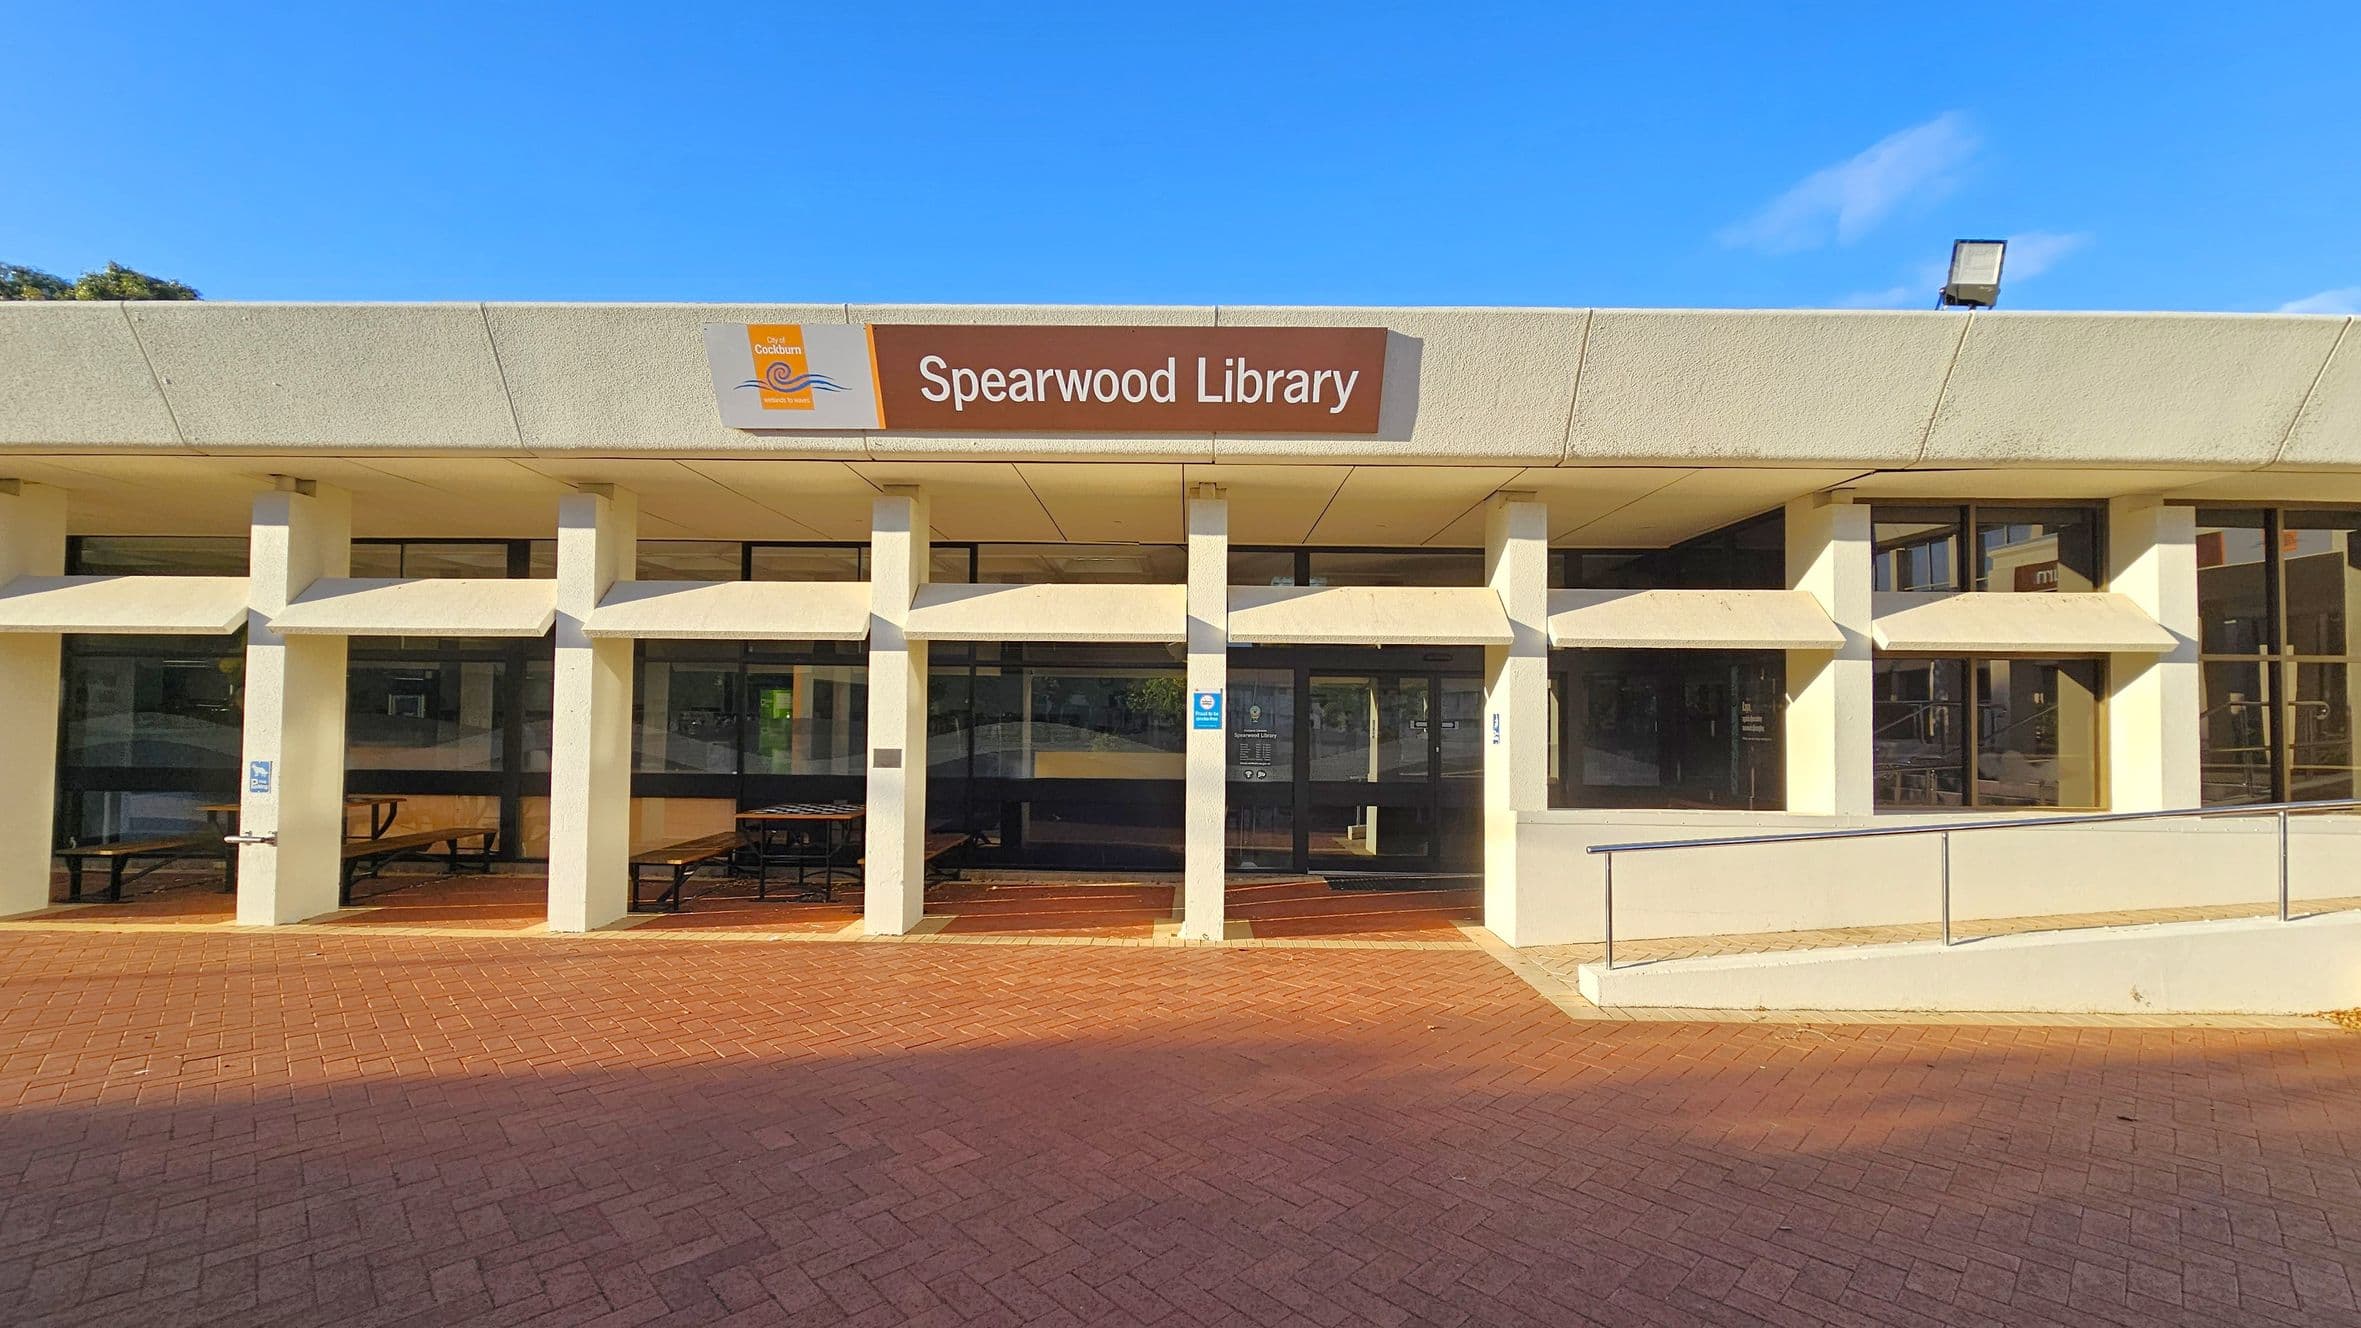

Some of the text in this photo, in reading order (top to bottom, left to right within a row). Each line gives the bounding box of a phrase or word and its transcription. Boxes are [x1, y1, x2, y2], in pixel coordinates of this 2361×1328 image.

[767, 336, 778, 344] City
[755, 344, 802, 355] Cockburn
[919, 355, 1359, 414] Spearwood Library
